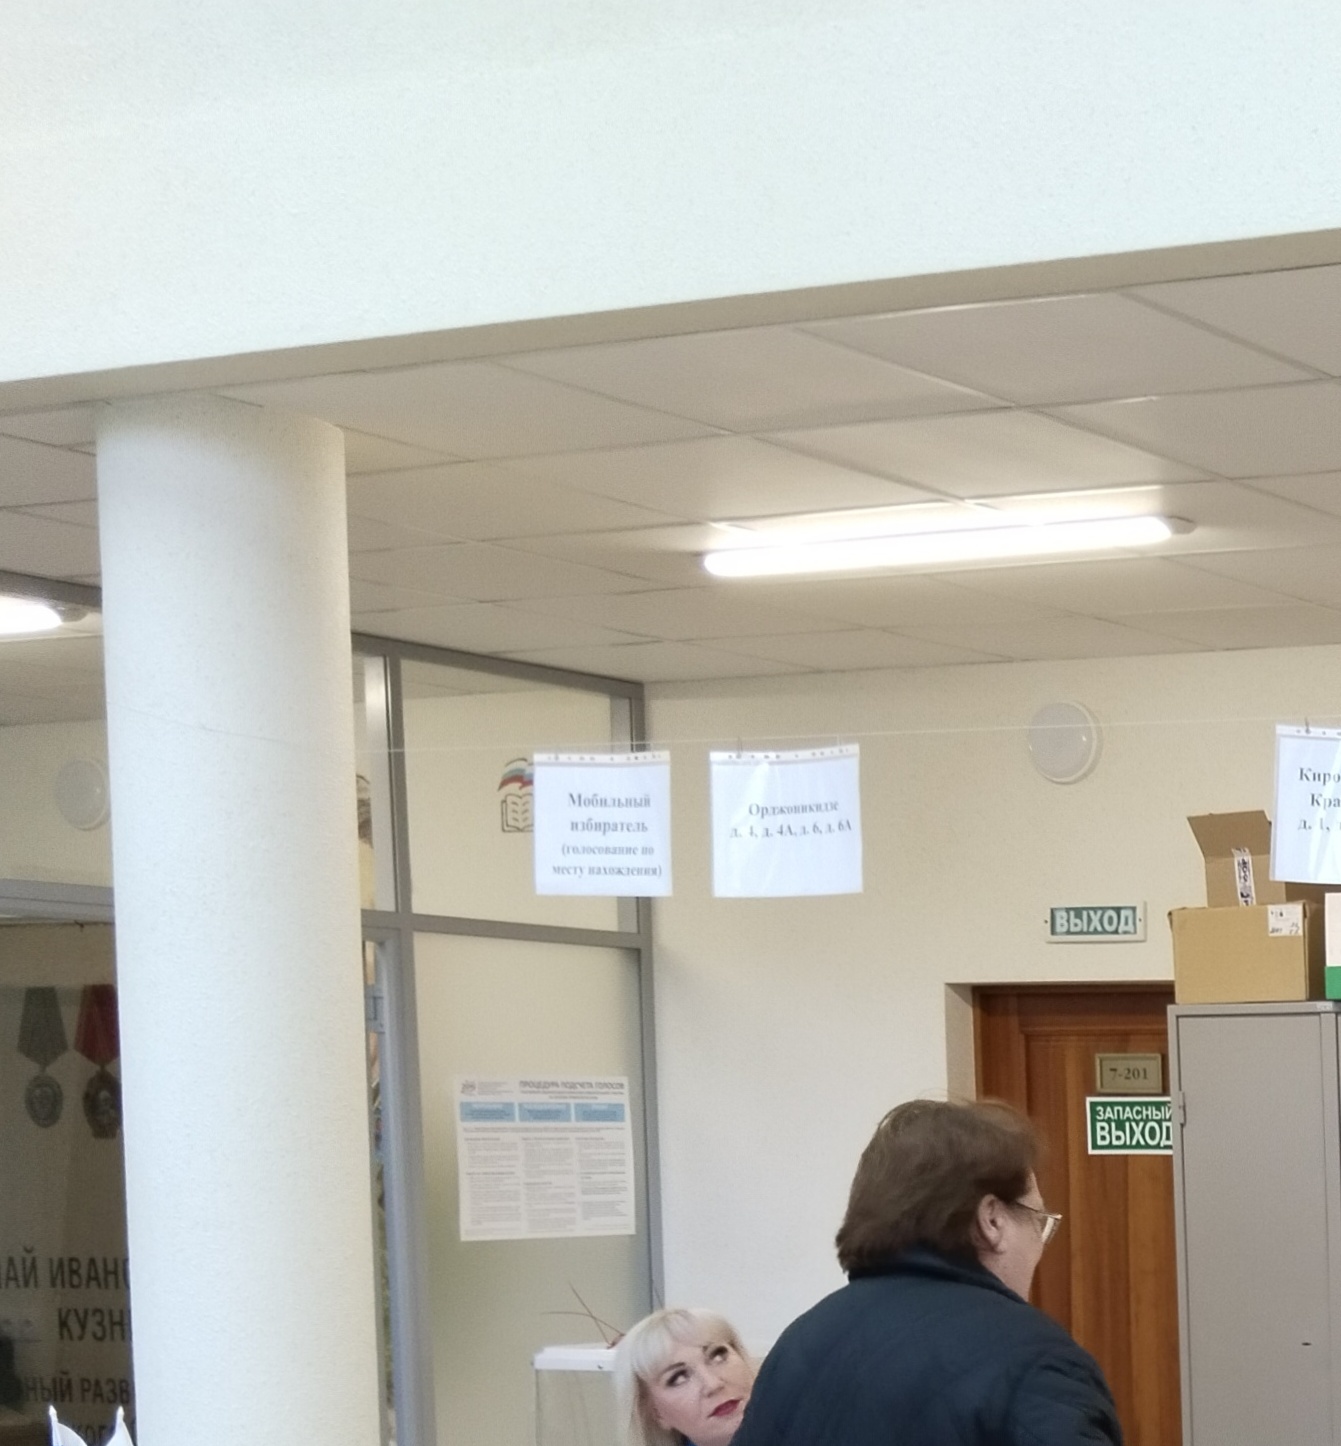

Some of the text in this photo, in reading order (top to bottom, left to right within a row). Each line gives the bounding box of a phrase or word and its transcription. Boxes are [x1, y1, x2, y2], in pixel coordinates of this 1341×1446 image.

[568, 793, 651, 808] Мобильный
[748, 801, 839, 819] Орджоникидзе
[570, 817, 649, 836] избиратель
[561, 844, 655, 857] (голосование по
[552, 865, 662, 878] месту нахождения)
[1055, 908, 1135, 934] ВЫХОД
[1109, 1067, 1149, 1080] 7-201
[1096, 1103, 1173, 1120] ЗАПАСНЫЙ
[1096, 1122, 1173, 1147] ВЫХОД
[0, 1246, 38, 1289] АЙ
[58, 1308, 132, 1342] КУЗН
[24, 1370, 73, 1402] НЫЙ
